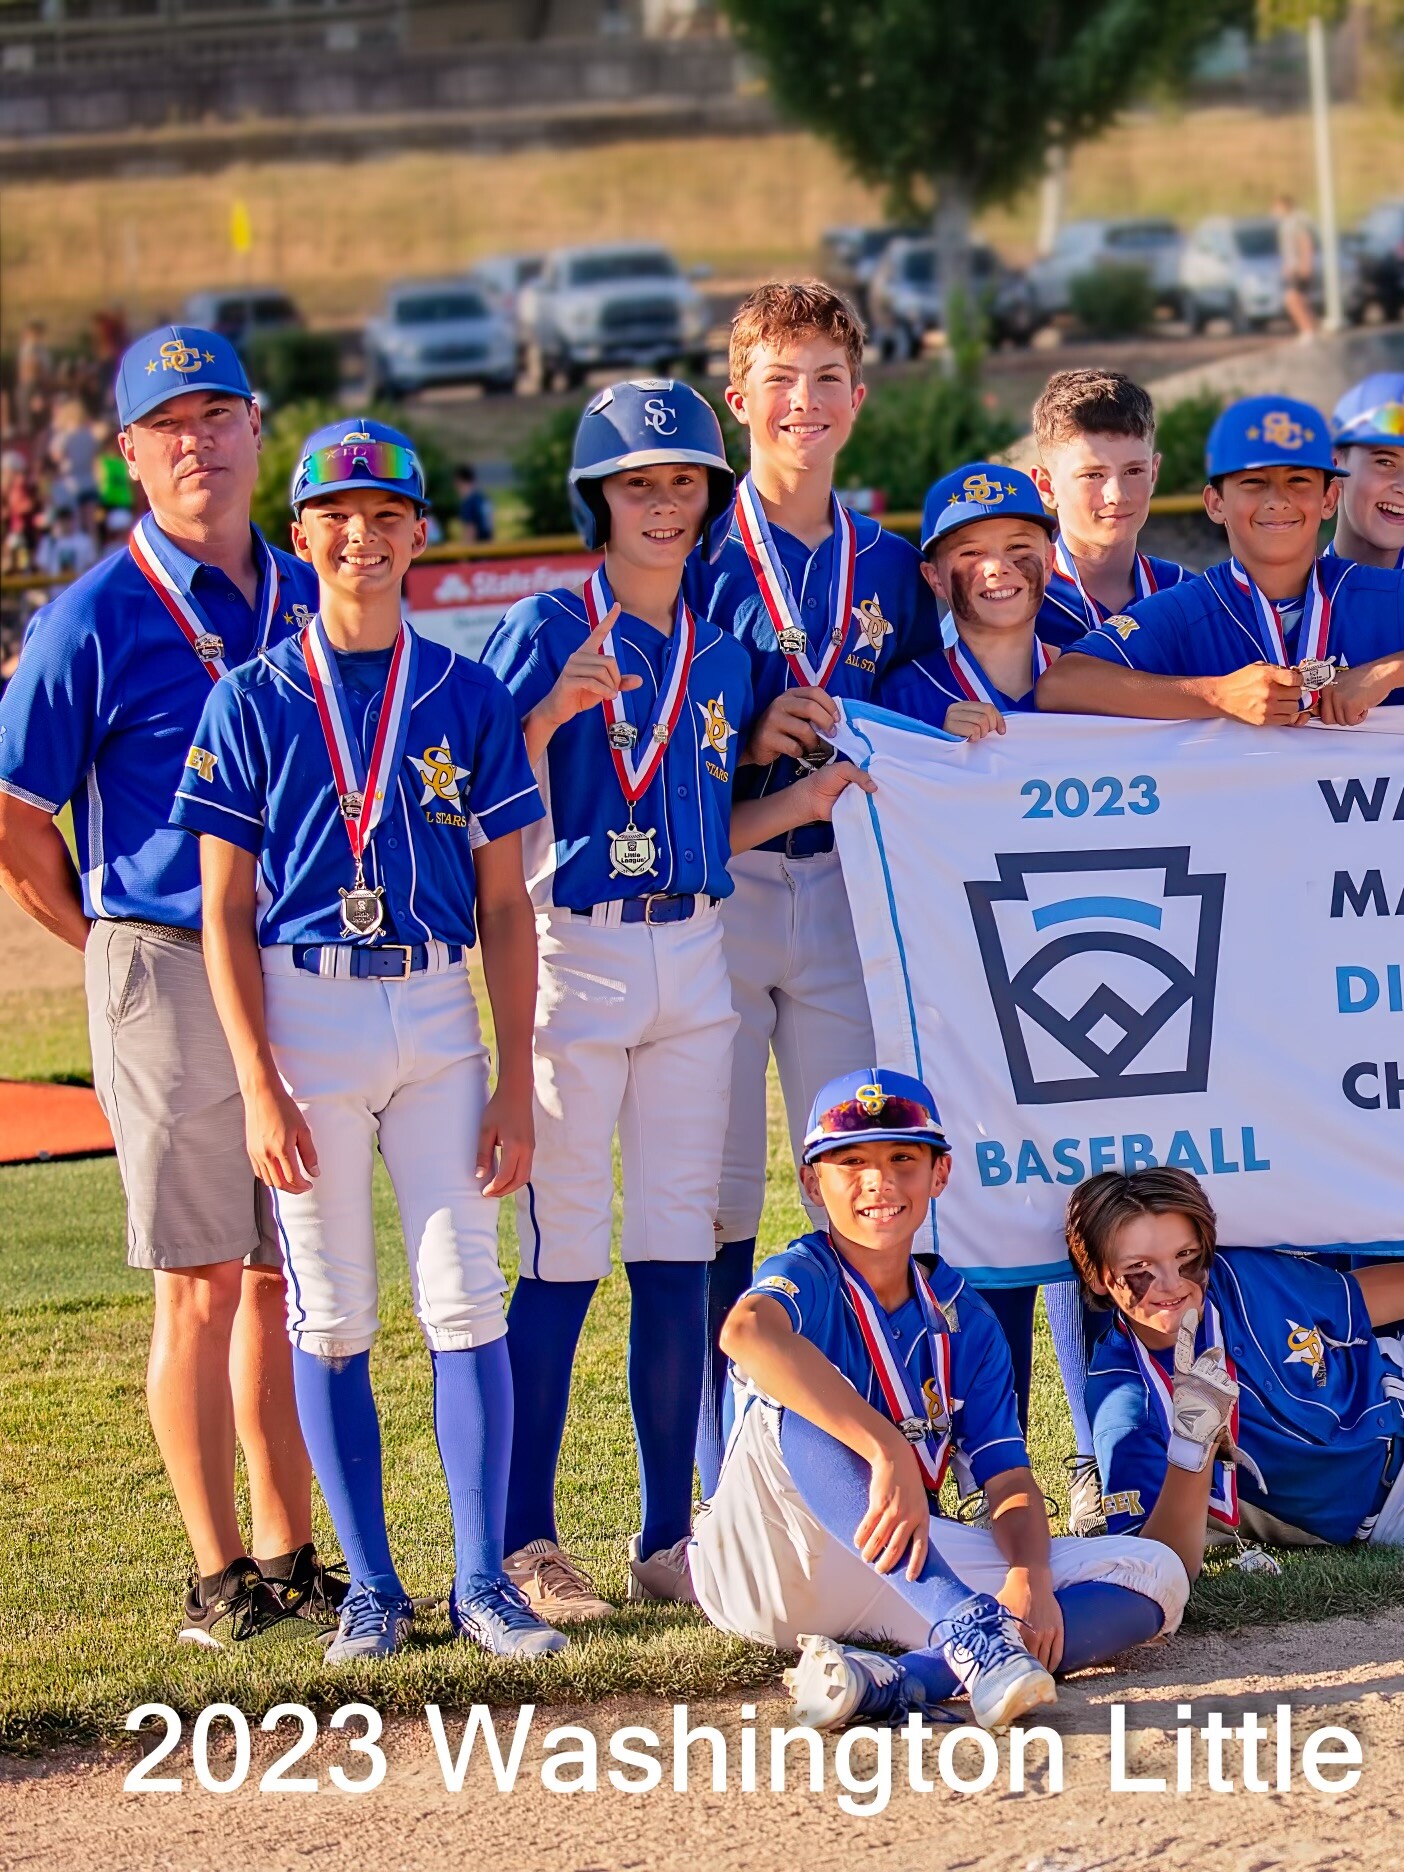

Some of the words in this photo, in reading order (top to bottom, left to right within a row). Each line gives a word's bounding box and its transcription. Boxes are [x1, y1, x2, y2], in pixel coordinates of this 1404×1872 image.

[644, 399, 678, 436] SC
[963, 474, 1004, 505] SC
[1020, 774, 1161, 819] 2023
[435, 812, 467, 828] STARS
[975, 1126, 1271, 1187] BASEBALL
